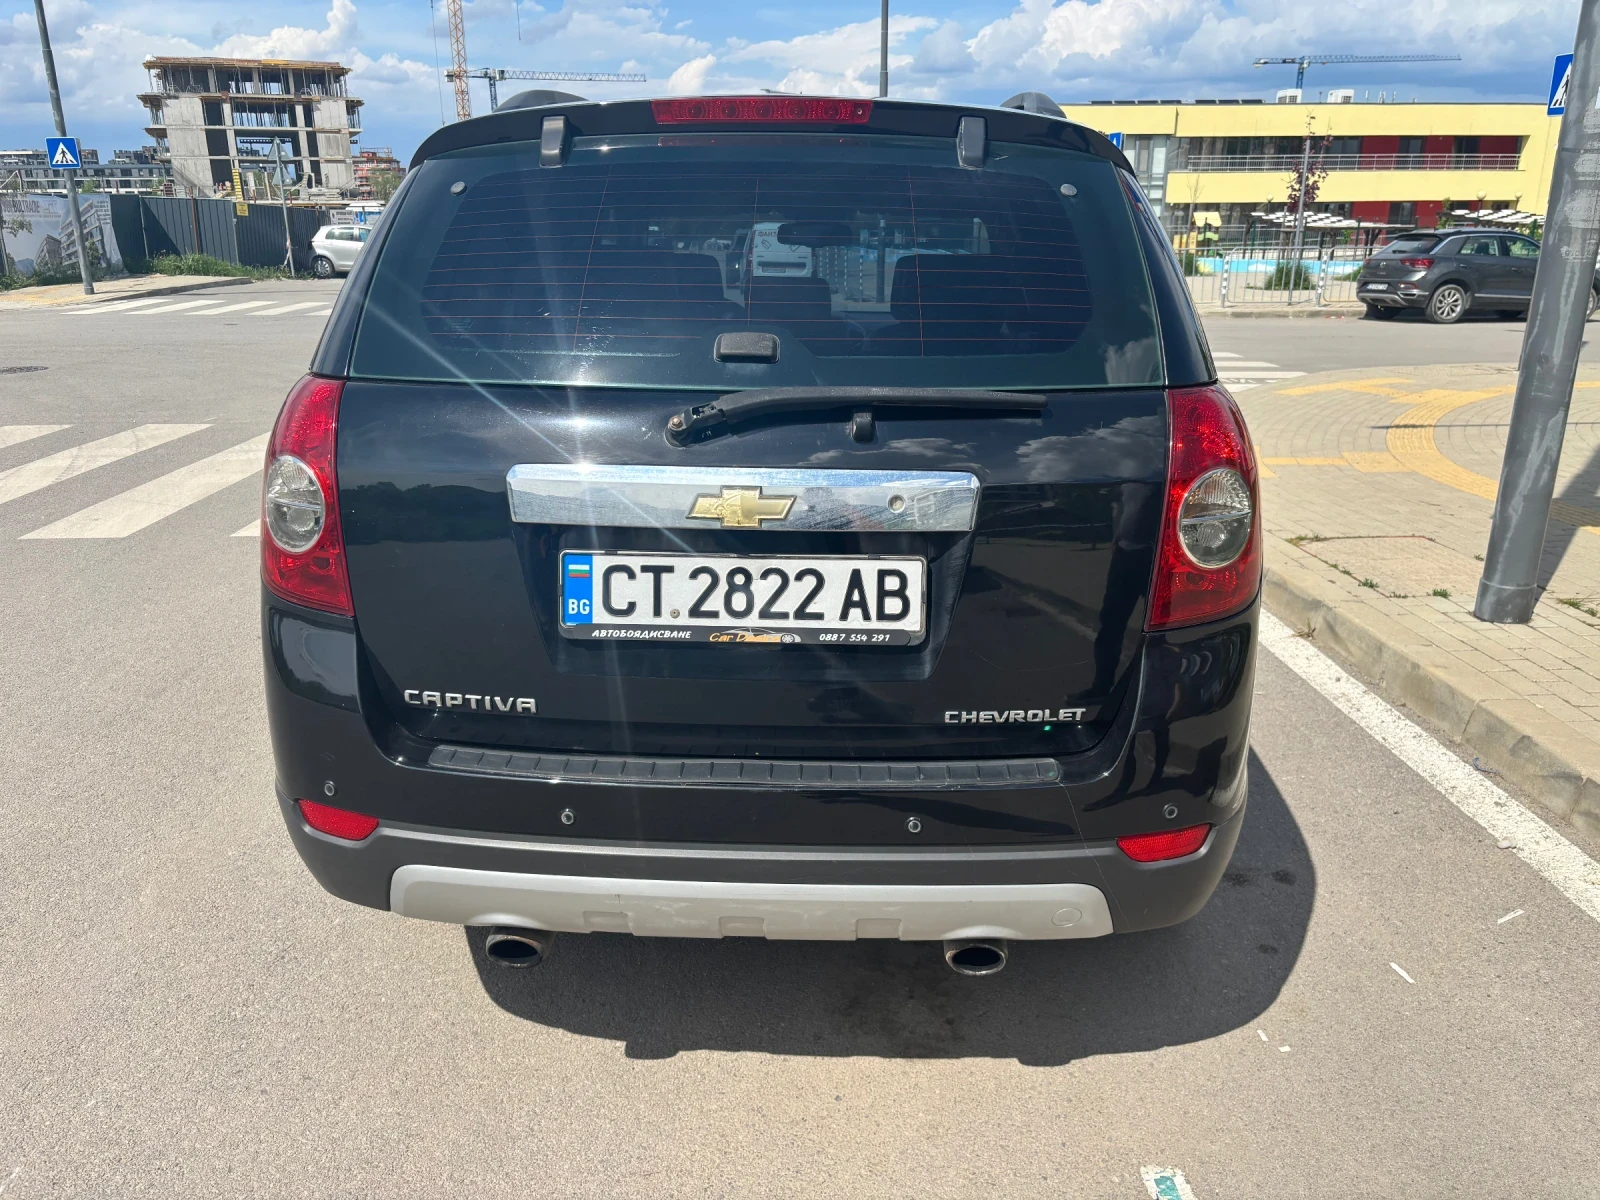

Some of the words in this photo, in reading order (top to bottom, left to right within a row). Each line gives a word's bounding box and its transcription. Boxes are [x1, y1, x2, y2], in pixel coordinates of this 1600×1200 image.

[602, 564, 675, 618] CT
[688, 565, 826, 620] 2822
[838, 568, 911, 622] AB
[568, 599, 590, 614] BG
[592, 629, 692, 639] АВТОБОЯДИСВАНЕ
[709, 632, 734, 643] Car
[819, 633, 846, 642] 0887
[849, 633, 868, 642] 554
[871, 634, 890, 642] 291
[404, 689, 537, 714] CAPTIVA
[944, 708, 1087, 723] CHEVROLET
